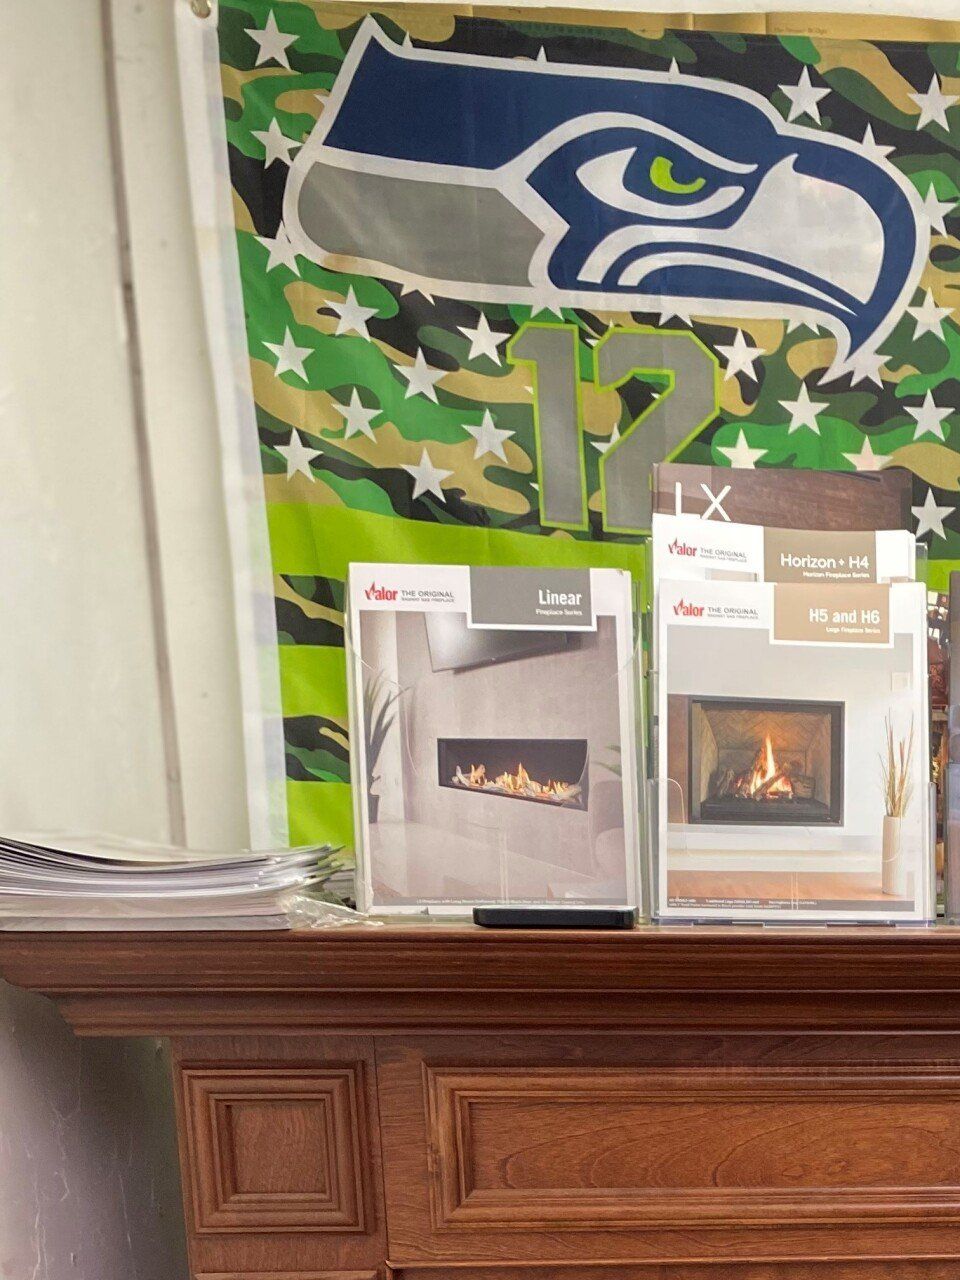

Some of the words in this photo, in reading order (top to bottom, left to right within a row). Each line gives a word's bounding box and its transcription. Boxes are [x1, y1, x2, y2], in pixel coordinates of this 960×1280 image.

[506, 321, 721, 533] 12
[715, 548, 747, 559] ORIGINAL
[780, 553, 836, 568] Horizon
[848, 556, 869, 569] H4
[417, 590, 454, 598] ORIGINAL
[538, 589, 582, 605] Linear
[707, 606, 722, 614] THE
[723, 607, 758, 615] ORIGINAL
[809, 608, 829, 622] H5
[832, 609, 857, 624] and
[861, 609, 880, 624] H6
